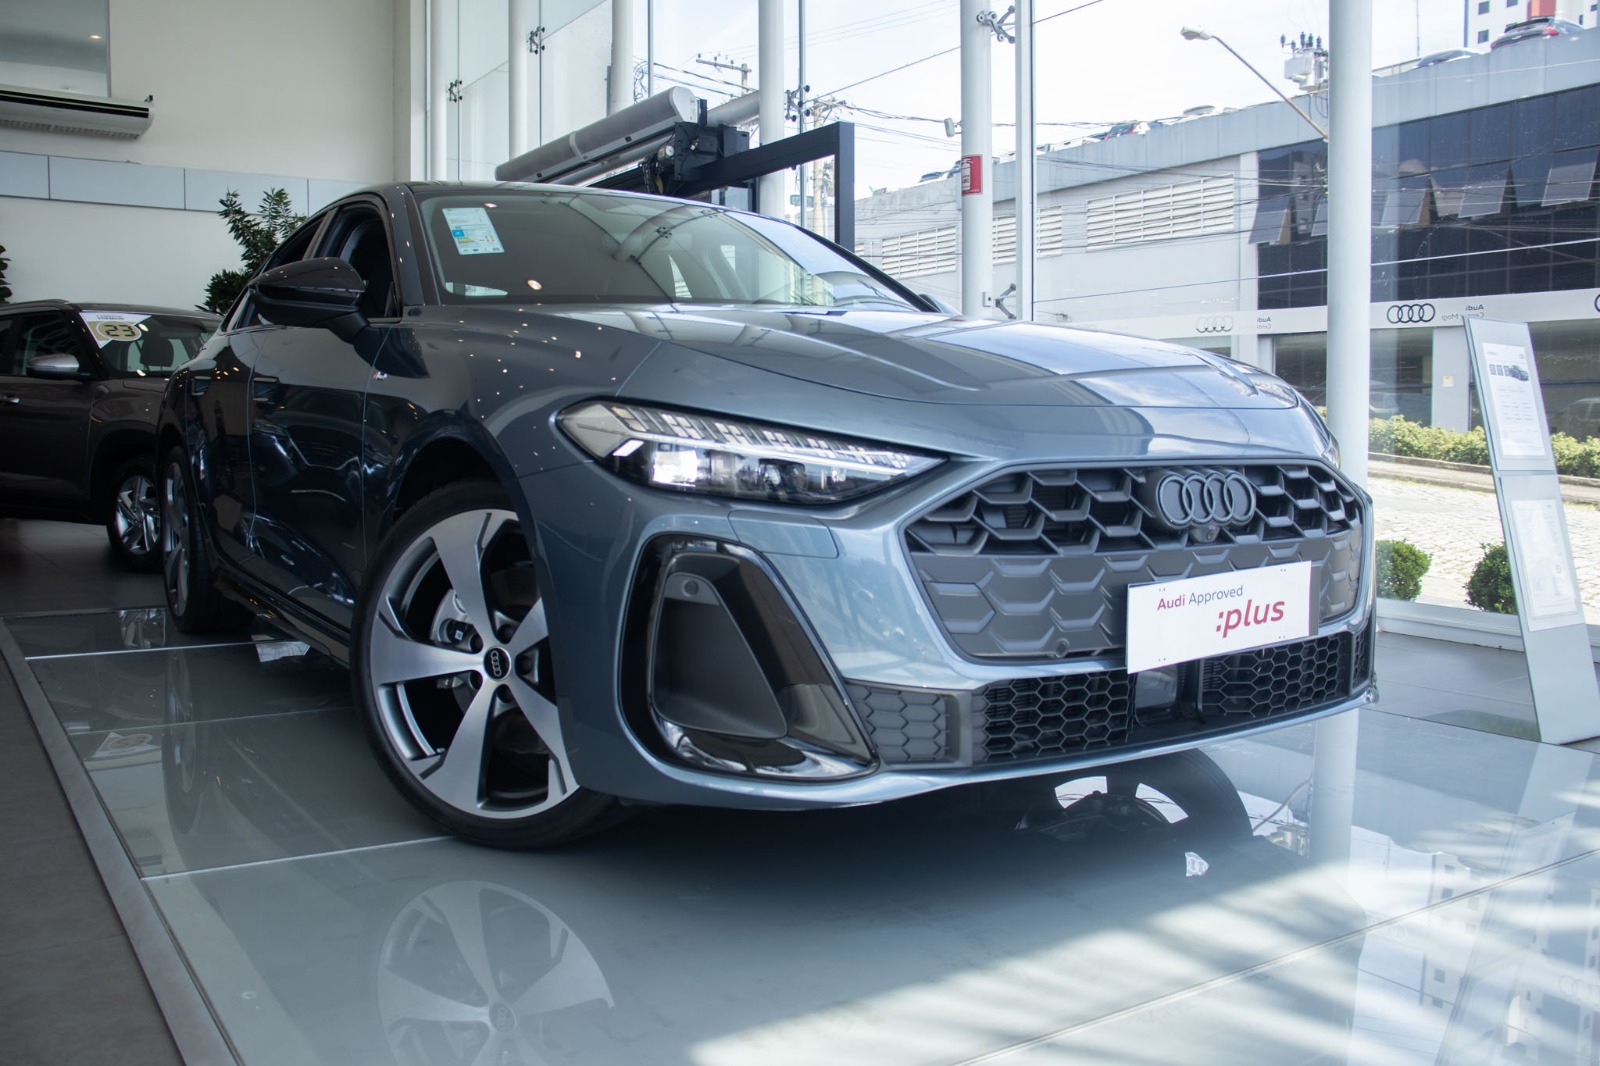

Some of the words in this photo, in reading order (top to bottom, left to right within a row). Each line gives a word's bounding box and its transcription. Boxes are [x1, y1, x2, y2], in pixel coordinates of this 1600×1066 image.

[104, 324, 136, 337] 23
[1157, 595, 1185, 611] Audi
[1188, 585, 1243, 606] Approved
